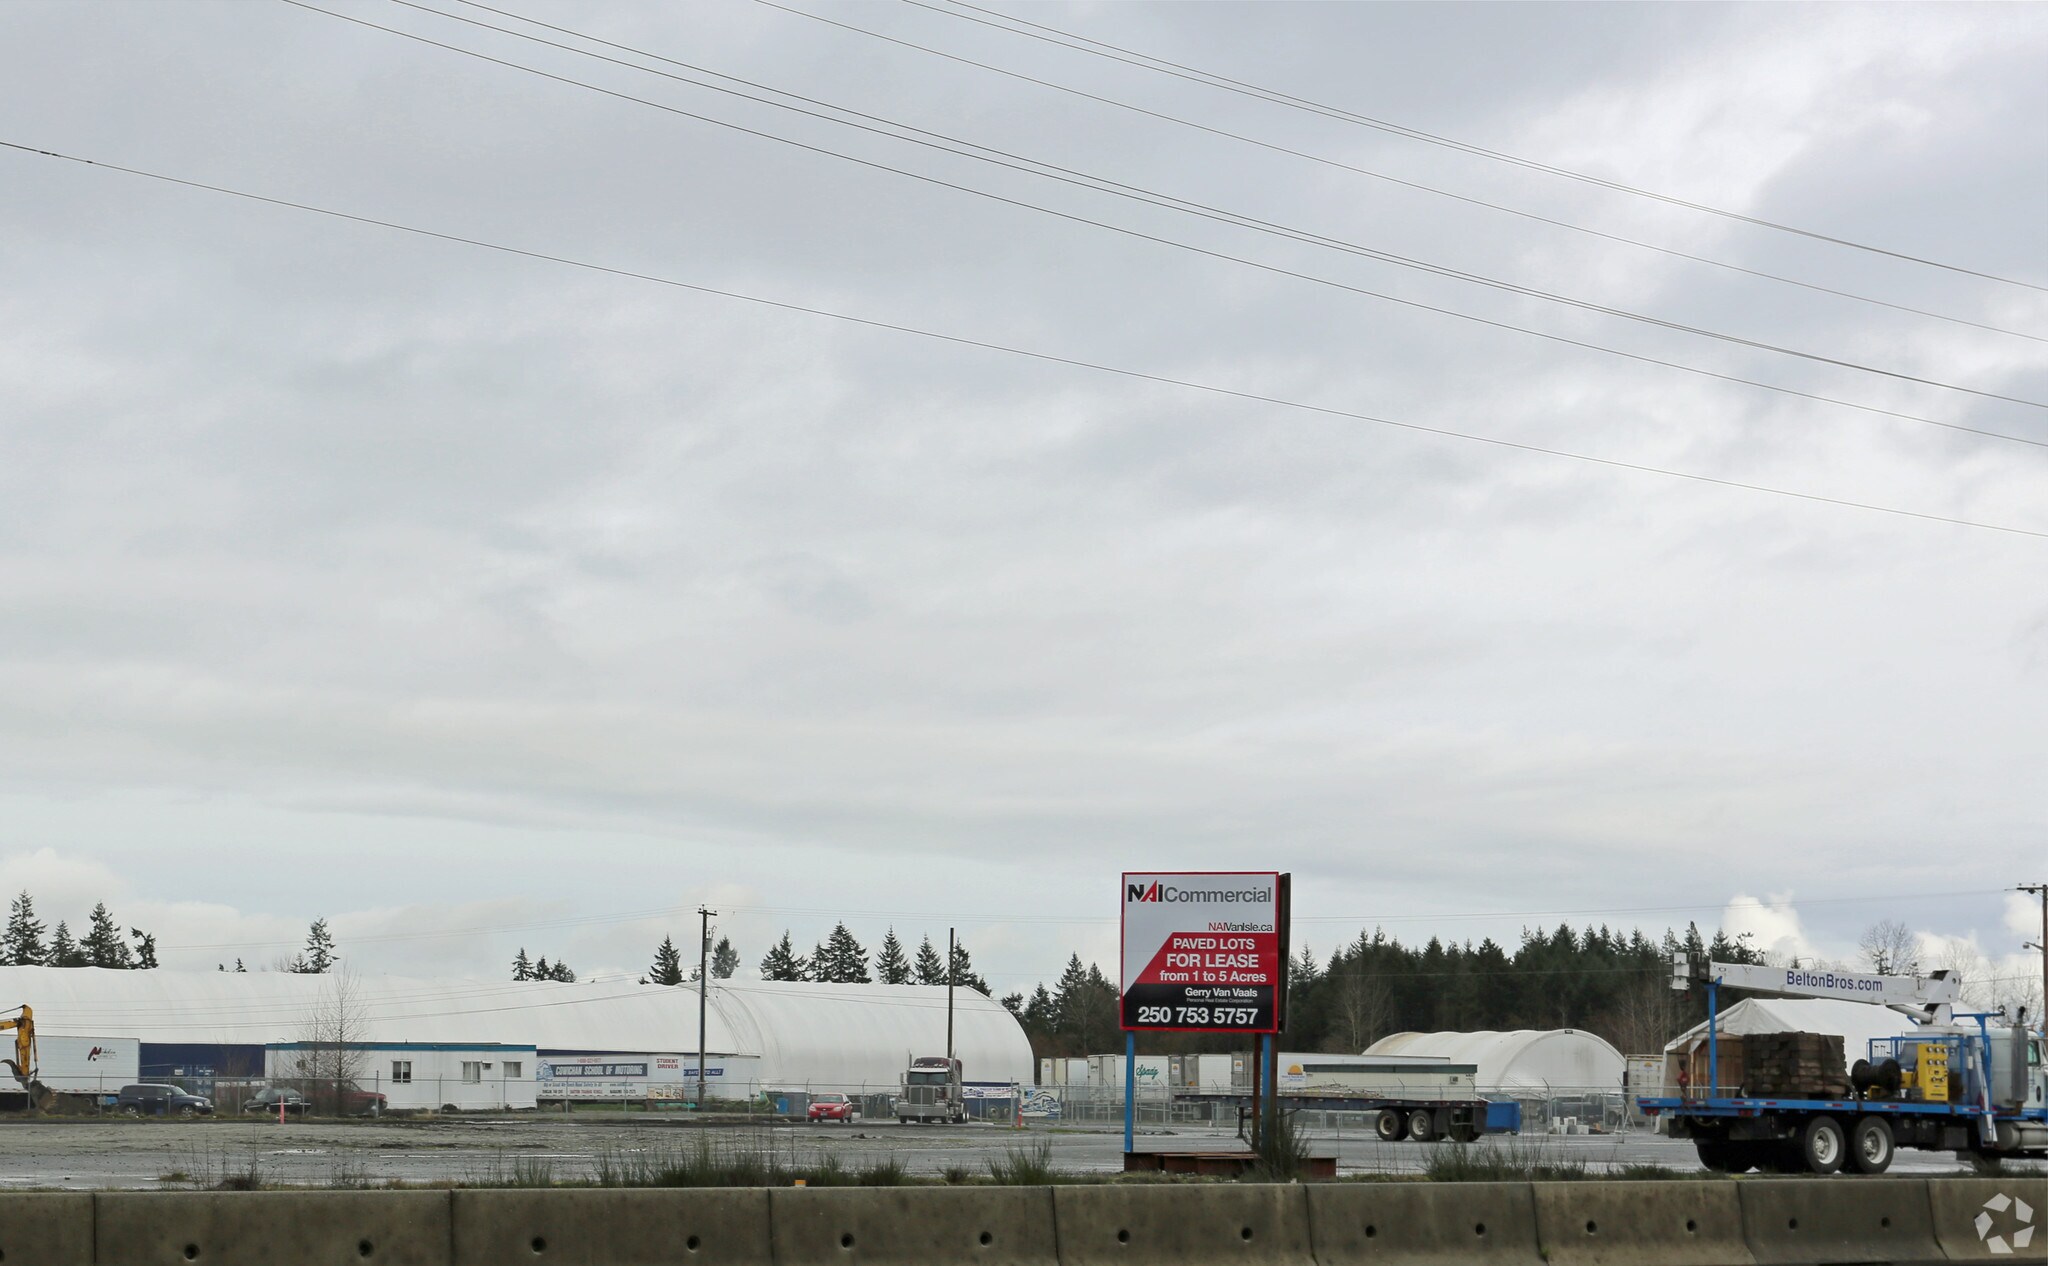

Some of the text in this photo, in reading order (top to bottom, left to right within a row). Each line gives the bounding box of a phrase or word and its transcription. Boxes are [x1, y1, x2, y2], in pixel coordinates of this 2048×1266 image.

[1208, 922, 1273, 932] NAIVanIsle.ca
[1173, 938, 1255, 950] PAVED LOTS
[1166, 953, 1259, 968] FOR LEASE
[1159, 970, 1267, 983] from 1 to 5 Acres
[1786, 970, 1883, 991] BeltonBros.com
[1185, 987, 1258, 998] Gerry Van Vaals
[1138, 1006, 1259, 1025] 250 753 5757
[584, 1066, 604, 1075] SCHOOL
[605, 1065, 613, 1074] OF
